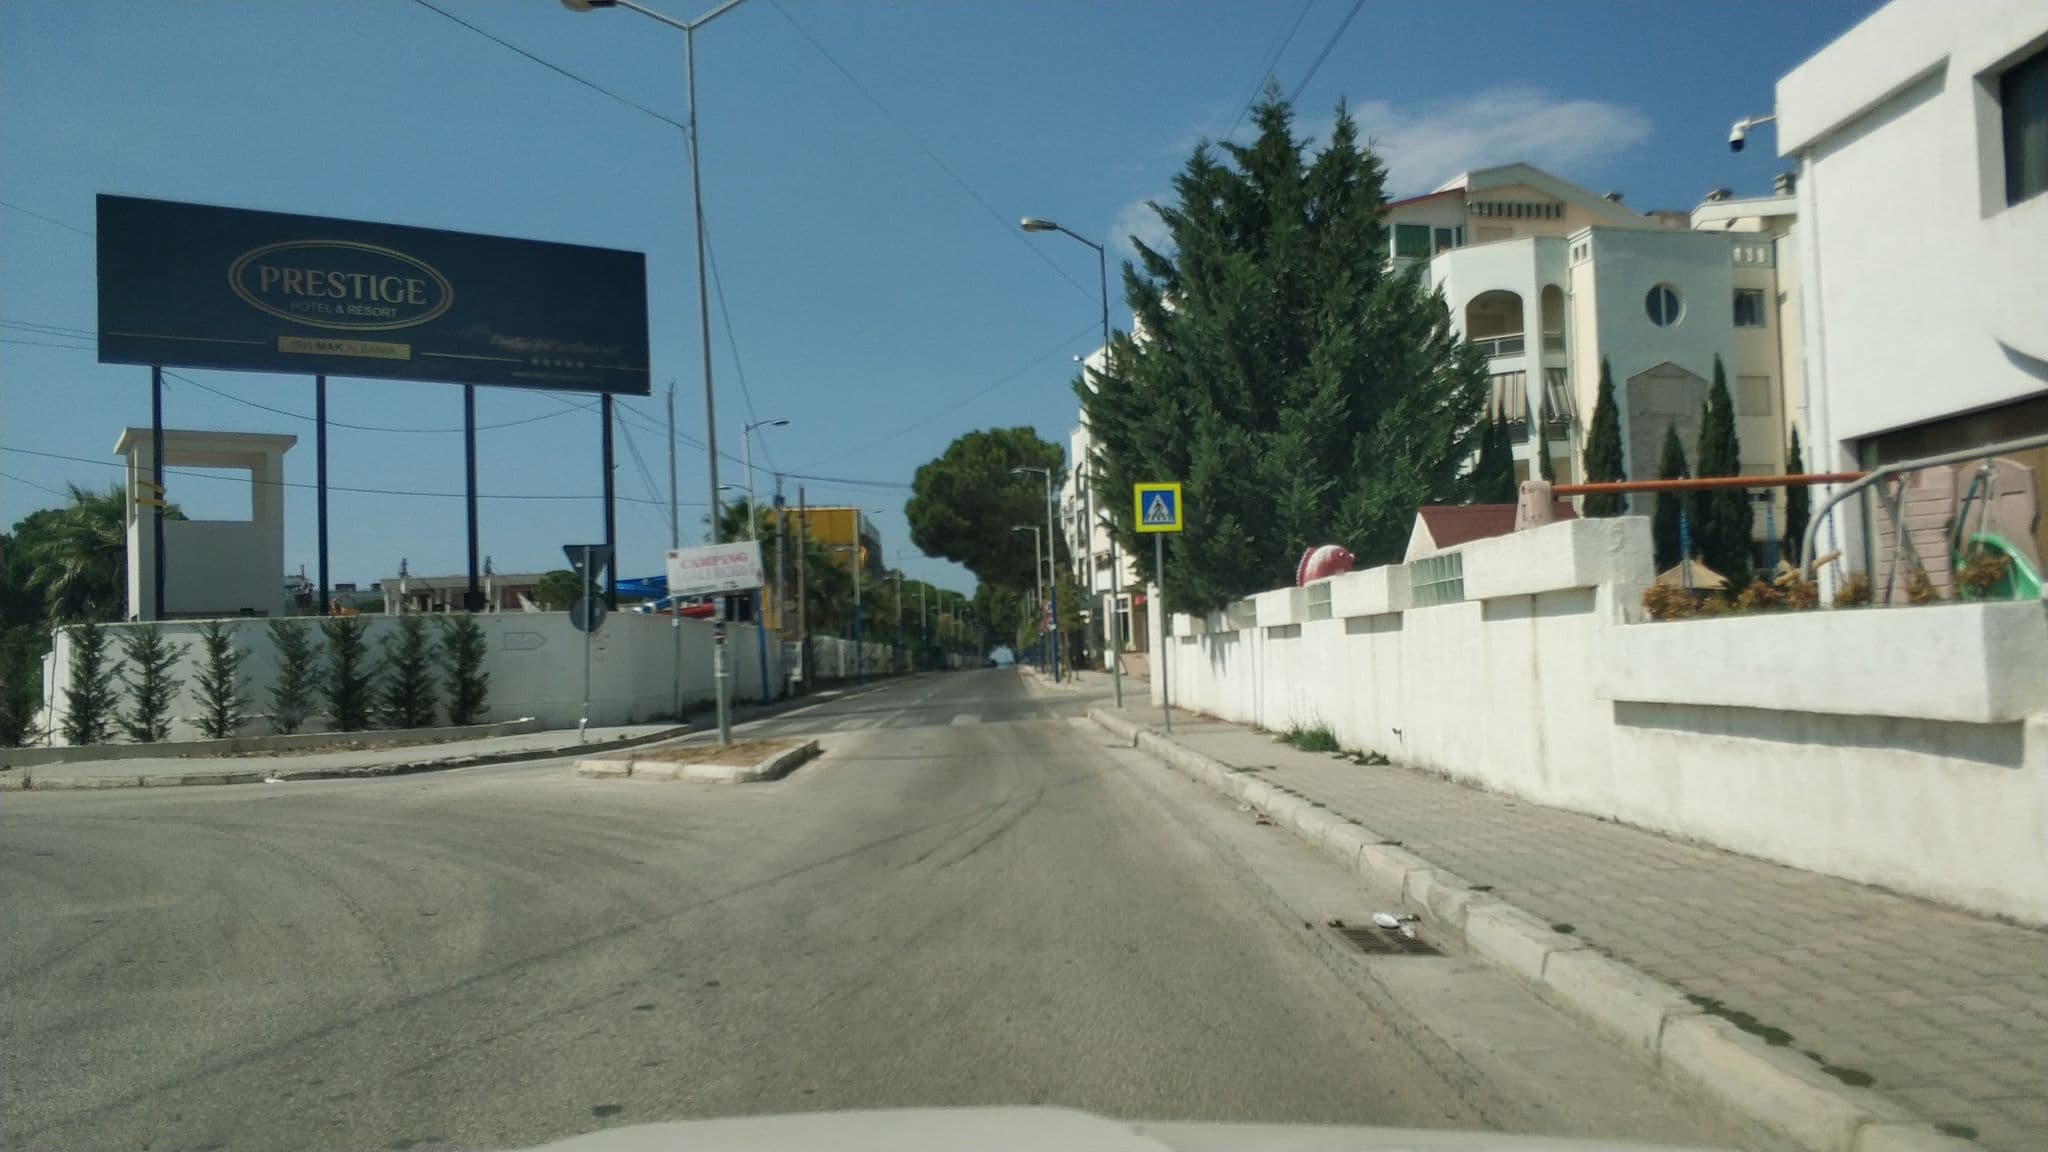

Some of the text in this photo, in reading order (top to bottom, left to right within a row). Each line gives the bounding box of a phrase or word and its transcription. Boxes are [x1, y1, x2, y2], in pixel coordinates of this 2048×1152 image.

[258, 264, 427, 305] PRESTIGE
[290, 301, 398, 318] HOTEL & RESORT
